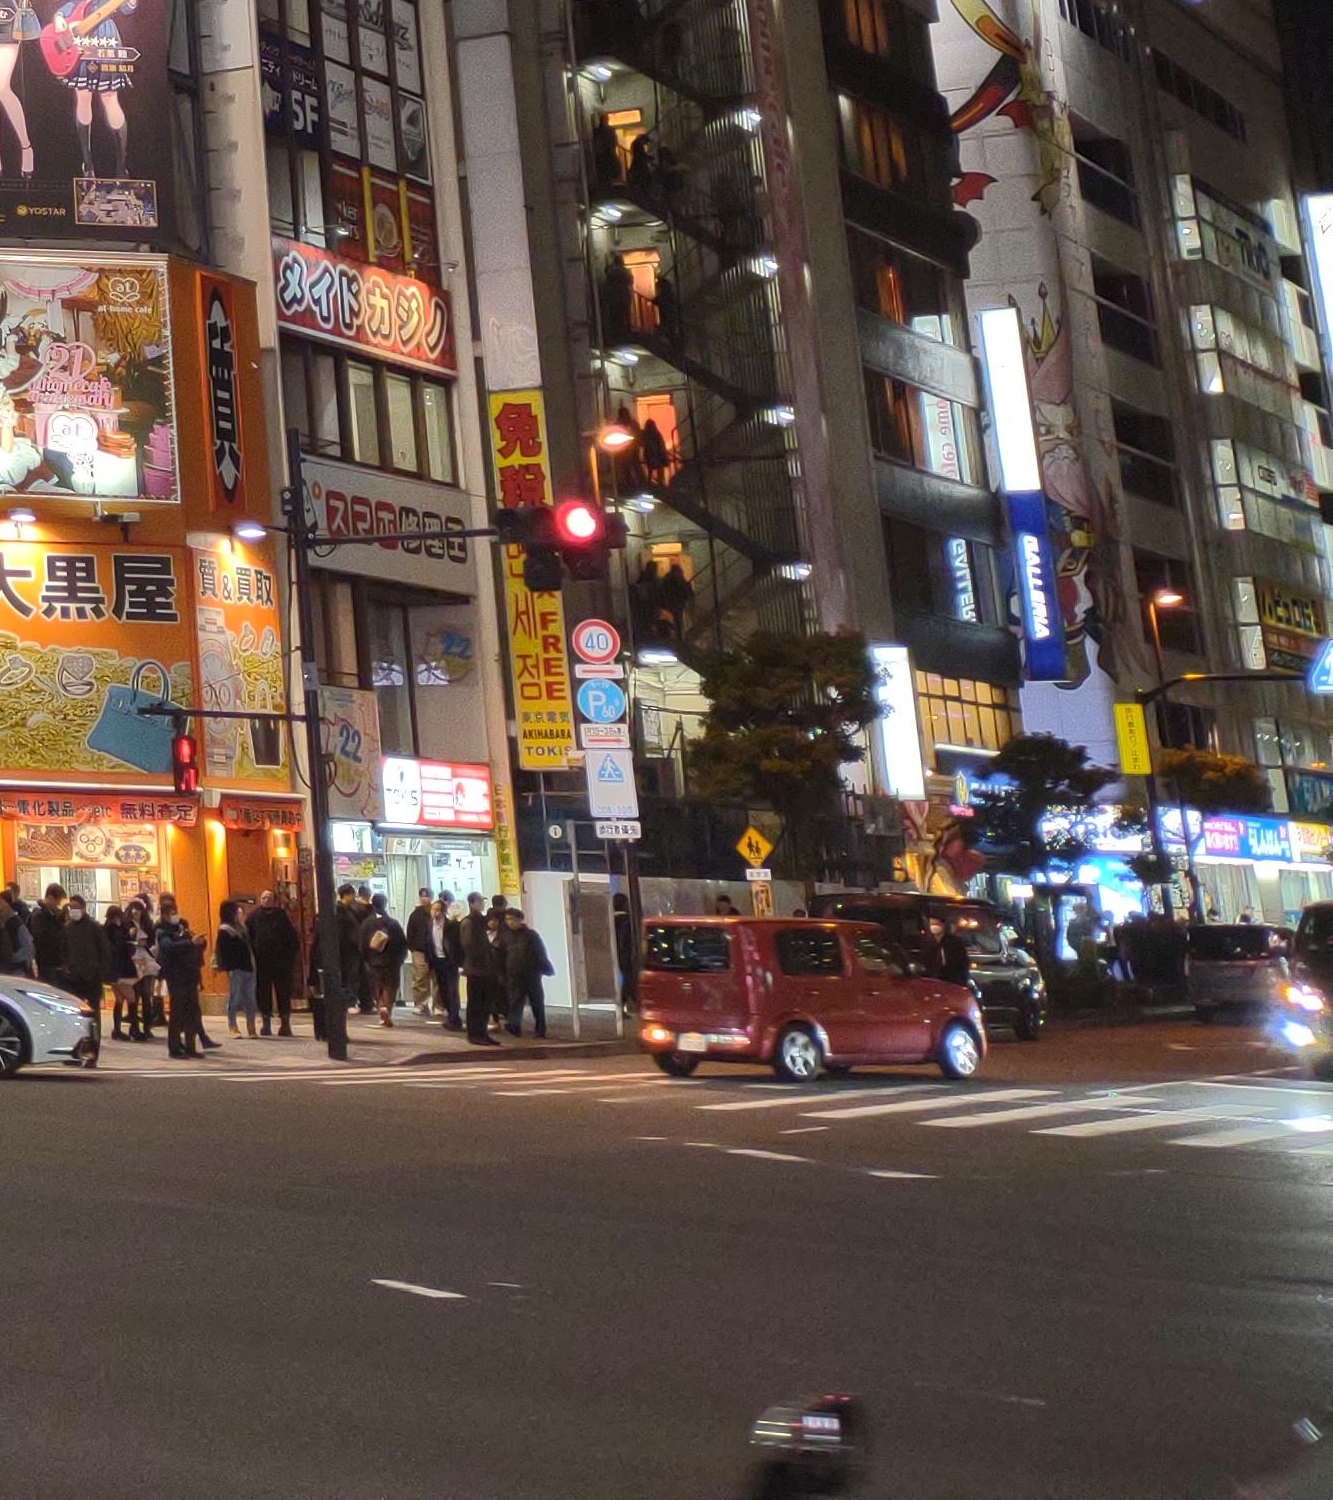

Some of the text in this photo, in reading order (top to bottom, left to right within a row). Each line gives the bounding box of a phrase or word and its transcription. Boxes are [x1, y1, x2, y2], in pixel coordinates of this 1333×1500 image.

[290, 88, 320, 135] 5F
[279, 250, 452, 358] メイドカジノ
[494, 402, 547, 507] 免税
[323, 488, 469, 564] スマホ修理王
[198, 556, 275, 609] 質&買取
[1022, 534, 1051, 640] GALLERIA
[539, 611, 568, 701] FREE
[584, 632, 609, 651] 40
[521, 728, 573, 740] AKIHABARA
[119, 802, 195, 823] 無料査定
